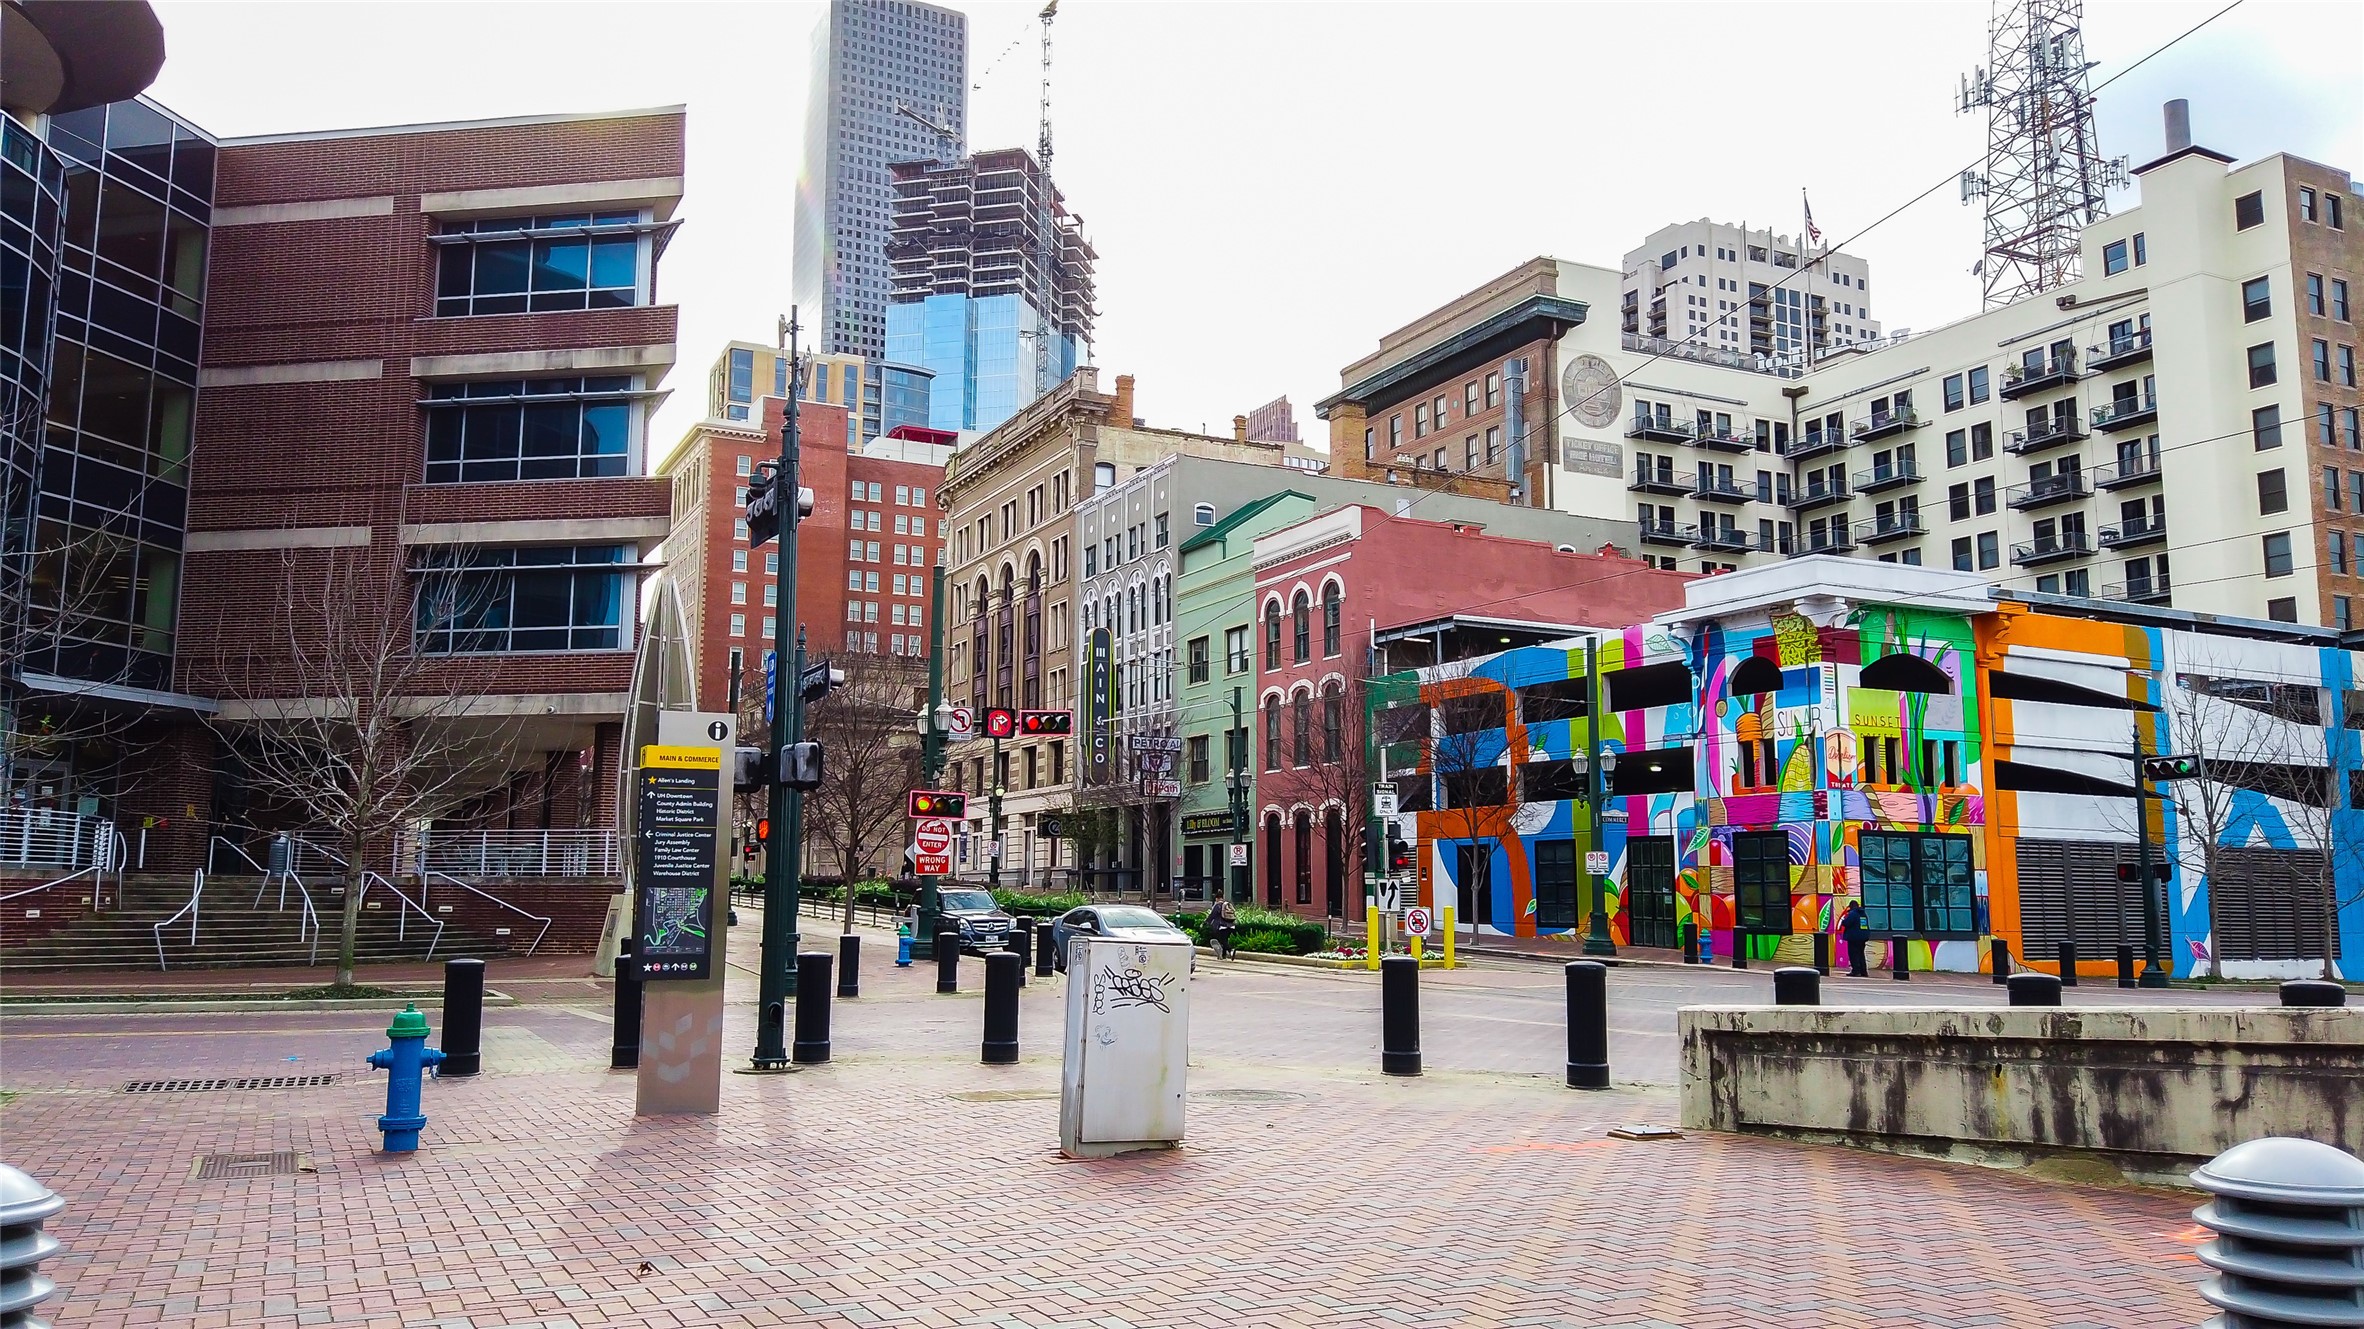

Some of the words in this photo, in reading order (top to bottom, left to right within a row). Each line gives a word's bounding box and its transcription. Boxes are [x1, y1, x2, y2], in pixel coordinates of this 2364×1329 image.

[1855, 713, 1900, 728] SUNSET
[1095, 737, 1105, 763] CO
[684, 755, 719, 763] COMMERCE
[656, 800, 675, 808] County
[693, 801, 713, 809] Building
[922, 841, 942, 849] ENTER
[920, 856, 946, 864] WRONG
[923, 864, 940, 872] WAY
